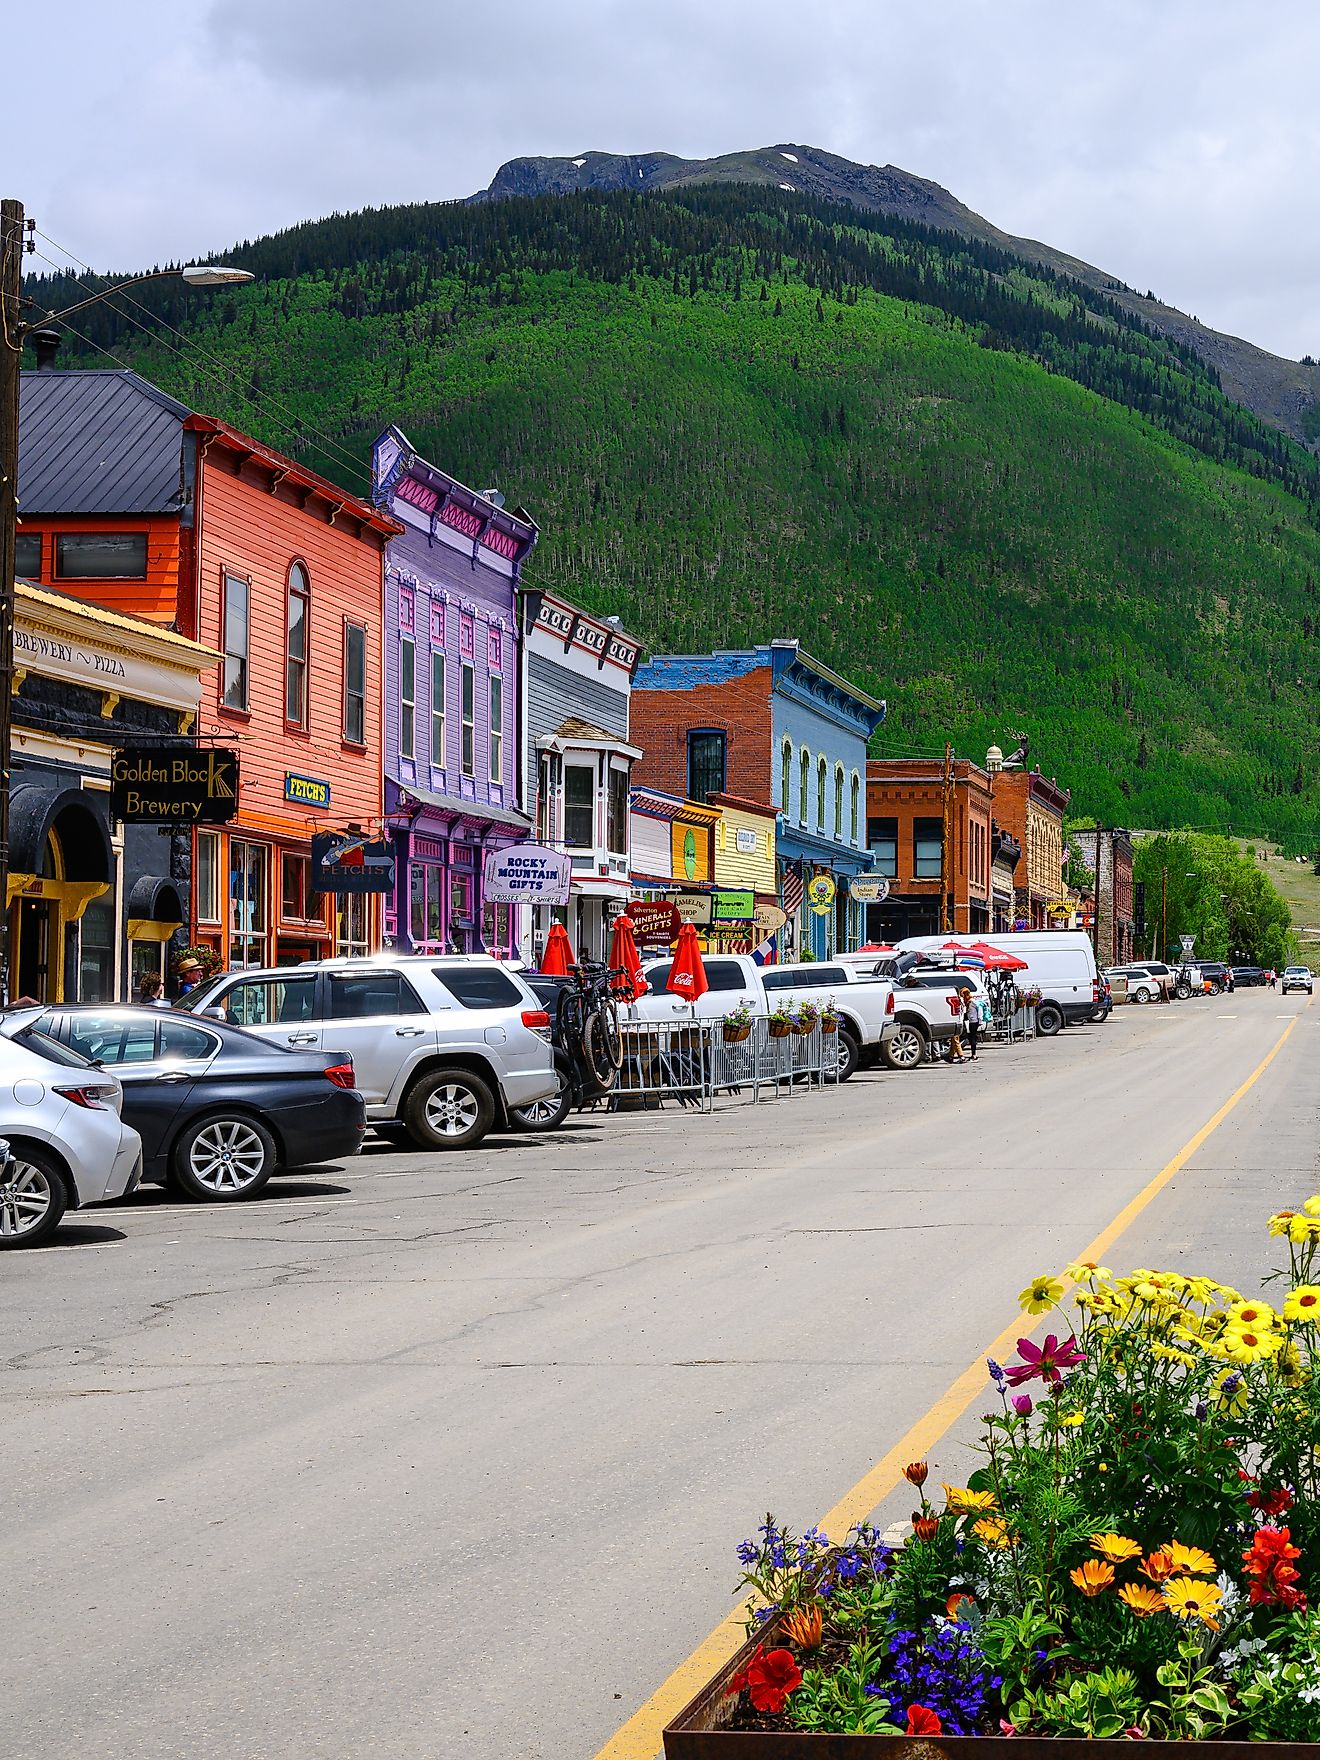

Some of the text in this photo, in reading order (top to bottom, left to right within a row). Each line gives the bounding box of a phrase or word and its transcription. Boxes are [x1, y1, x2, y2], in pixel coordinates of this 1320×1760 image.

[14, 630, 125, 677] BREWERY PIZZA
[113, 759, 168, 782] Golden
[290, 777, 325, 802] FETCH'S
[127, 791, 202, 818] Brewery
[507, 857, 547, 868] ROCKY
[498, 868, 558, 880] MOUNTAIN
[509, 880, 544, 890] GIFTS
[641, 919, 672, 932] GIFTS
[709, 931, 720, 939] ICE
